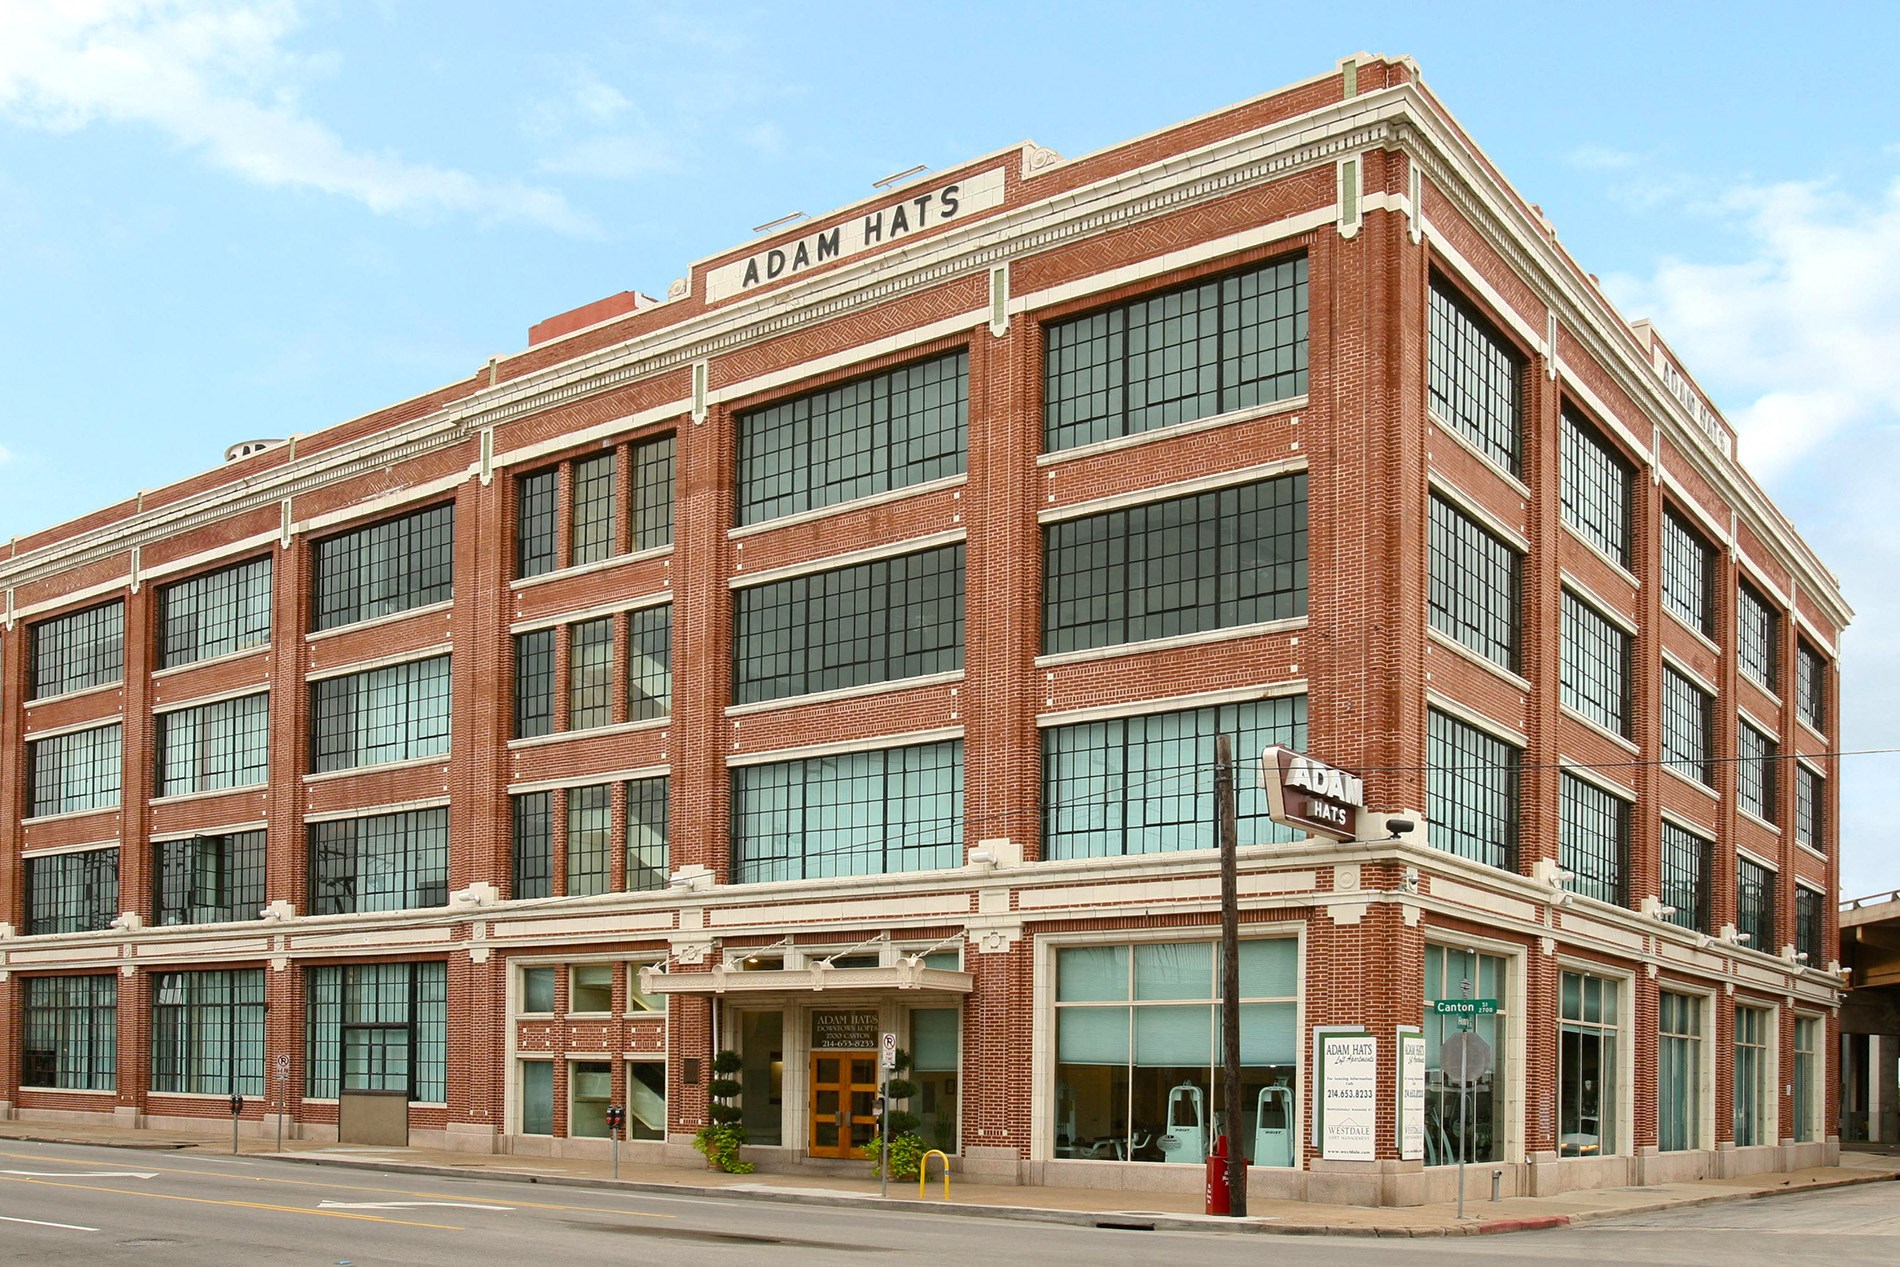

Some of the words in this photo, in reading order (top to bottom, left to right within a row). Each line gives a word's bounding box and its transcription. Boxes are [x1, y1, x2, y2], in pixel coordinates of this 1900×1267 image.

[742, 227, 840, 288] ADAM
[864, 185, 959, 245] HATS
[1663, 361, 1695, 417] ADAM
[1700, 404, 1725, 453] HATS
[1285, 758, 1363, 807] ADAM
[1314, 801, 1346, 826] HATS
[1437, 1002, 1475, 1012] Canton
[817, 1015, 847, 1025] ADAM
[851, 1015, 879, 1025] HATS
[1326, 1044, 1350, 1055] ADAM
[1352, 1044, 1373, 1055] HATS
[1327, 1089, 1373, 1098] 214.653.8233
[1328, 1126, 1371, 1136] WESTDALE
